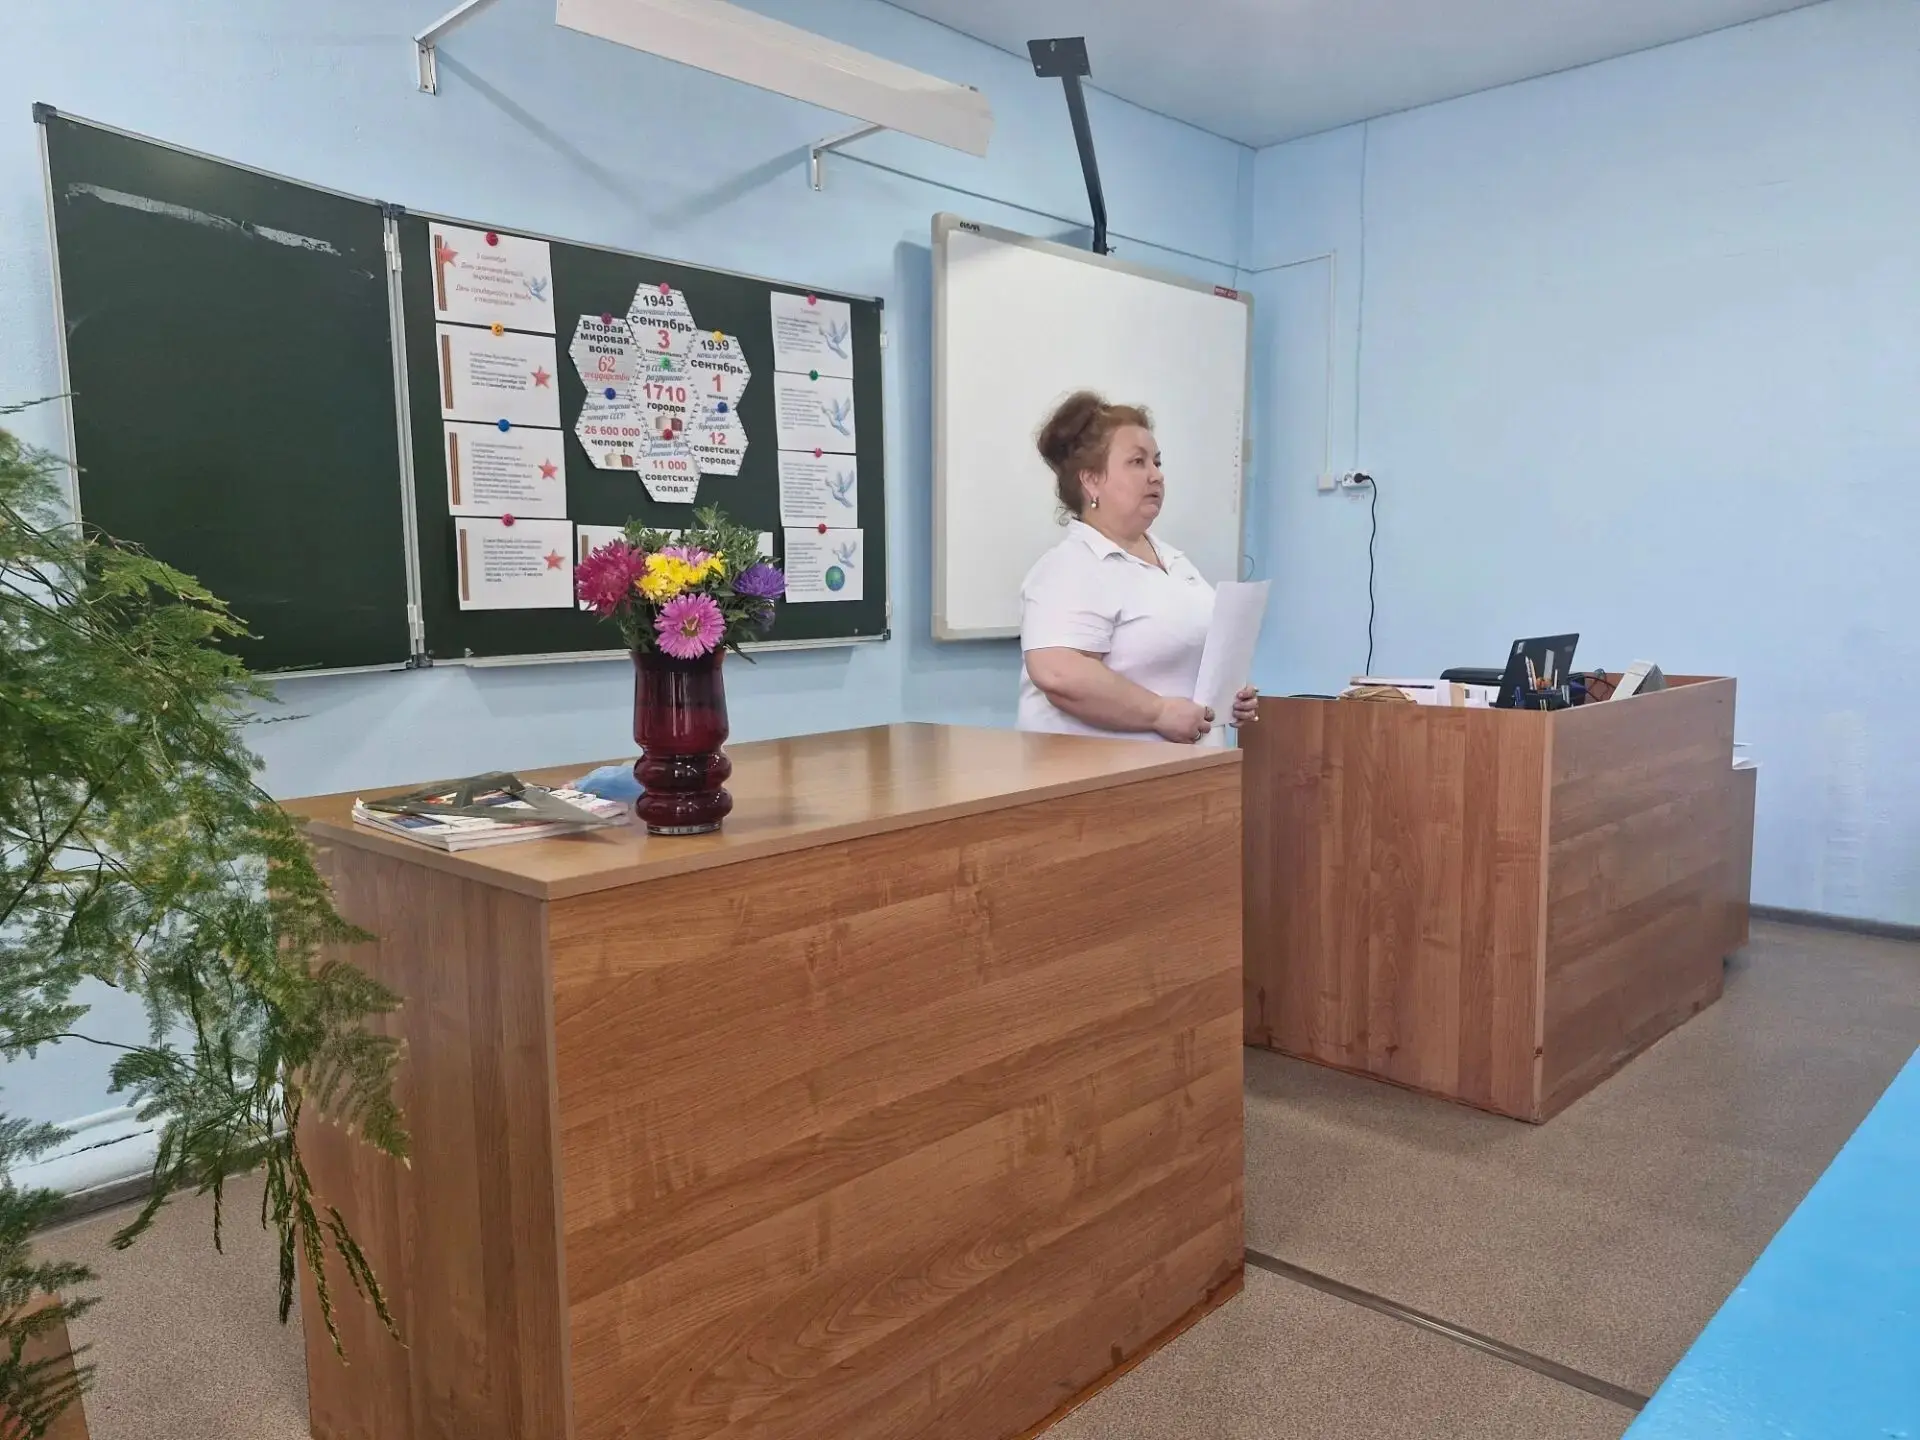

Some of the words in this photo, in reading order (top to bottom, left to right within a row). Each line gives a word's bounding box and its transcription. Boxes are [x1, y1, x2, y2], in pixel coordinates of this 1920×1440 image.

[643, 295, 674, 307] 1945
[583, 320, 624, 334] Вторая
[631, 315, 692, 334] сентябрь
[580, 332, 630, 345] мировая
[657, 329, 671, 349] 3
[589, 344, 624, 356] война
[701, 339, 730, 351] 1939
[598, 355, 616, 373] 62
[690, 359, 744, 375] сентябрь
[712, 373, 721, 392] 1
[643, 382, 687, 403] 1710
[647, 402, 686, 413] городов
[584, 425, 598, 435] 26
[600, 426, 619, 436] 600
[622, 427, 641, 437] 000
[591, 438, 634, 447] человек
[709, 431, 727, 446] 12
[693, 444, 740, 454] советских
[652, 460, 664, 470] 11
[668, 460, 687, 471] 000
[700, 456, 736, 466] городов
[645, 473, 695, 483] советских
[655, 485, 689, 493] солдат
